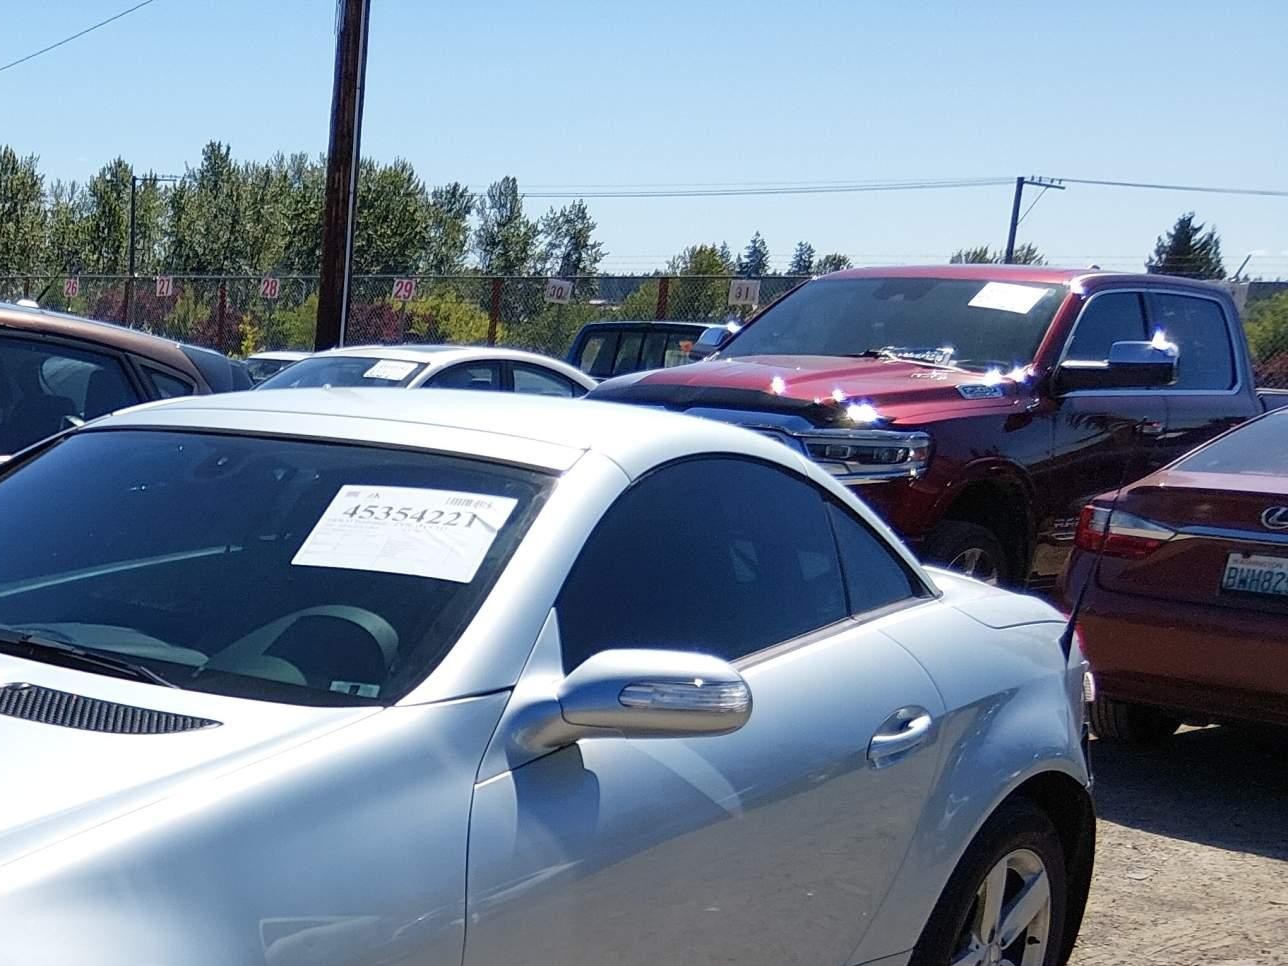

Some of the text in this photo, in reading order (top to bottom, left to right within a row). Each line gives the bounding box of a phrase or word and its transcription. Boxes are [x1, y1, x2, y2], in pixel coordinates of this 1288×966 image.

[65, 280, 77, 296] 26
[158, 279, 170, 295] 27
[262, 279, 278, 297] 28
[395, 280, 413, 300] 29
[550, 286, 564, 299] 30
[735, 286, 750, 300] 31
[342, 504, 478, 528] 45354221
[1225, 567, 1288, 594] BWH82
